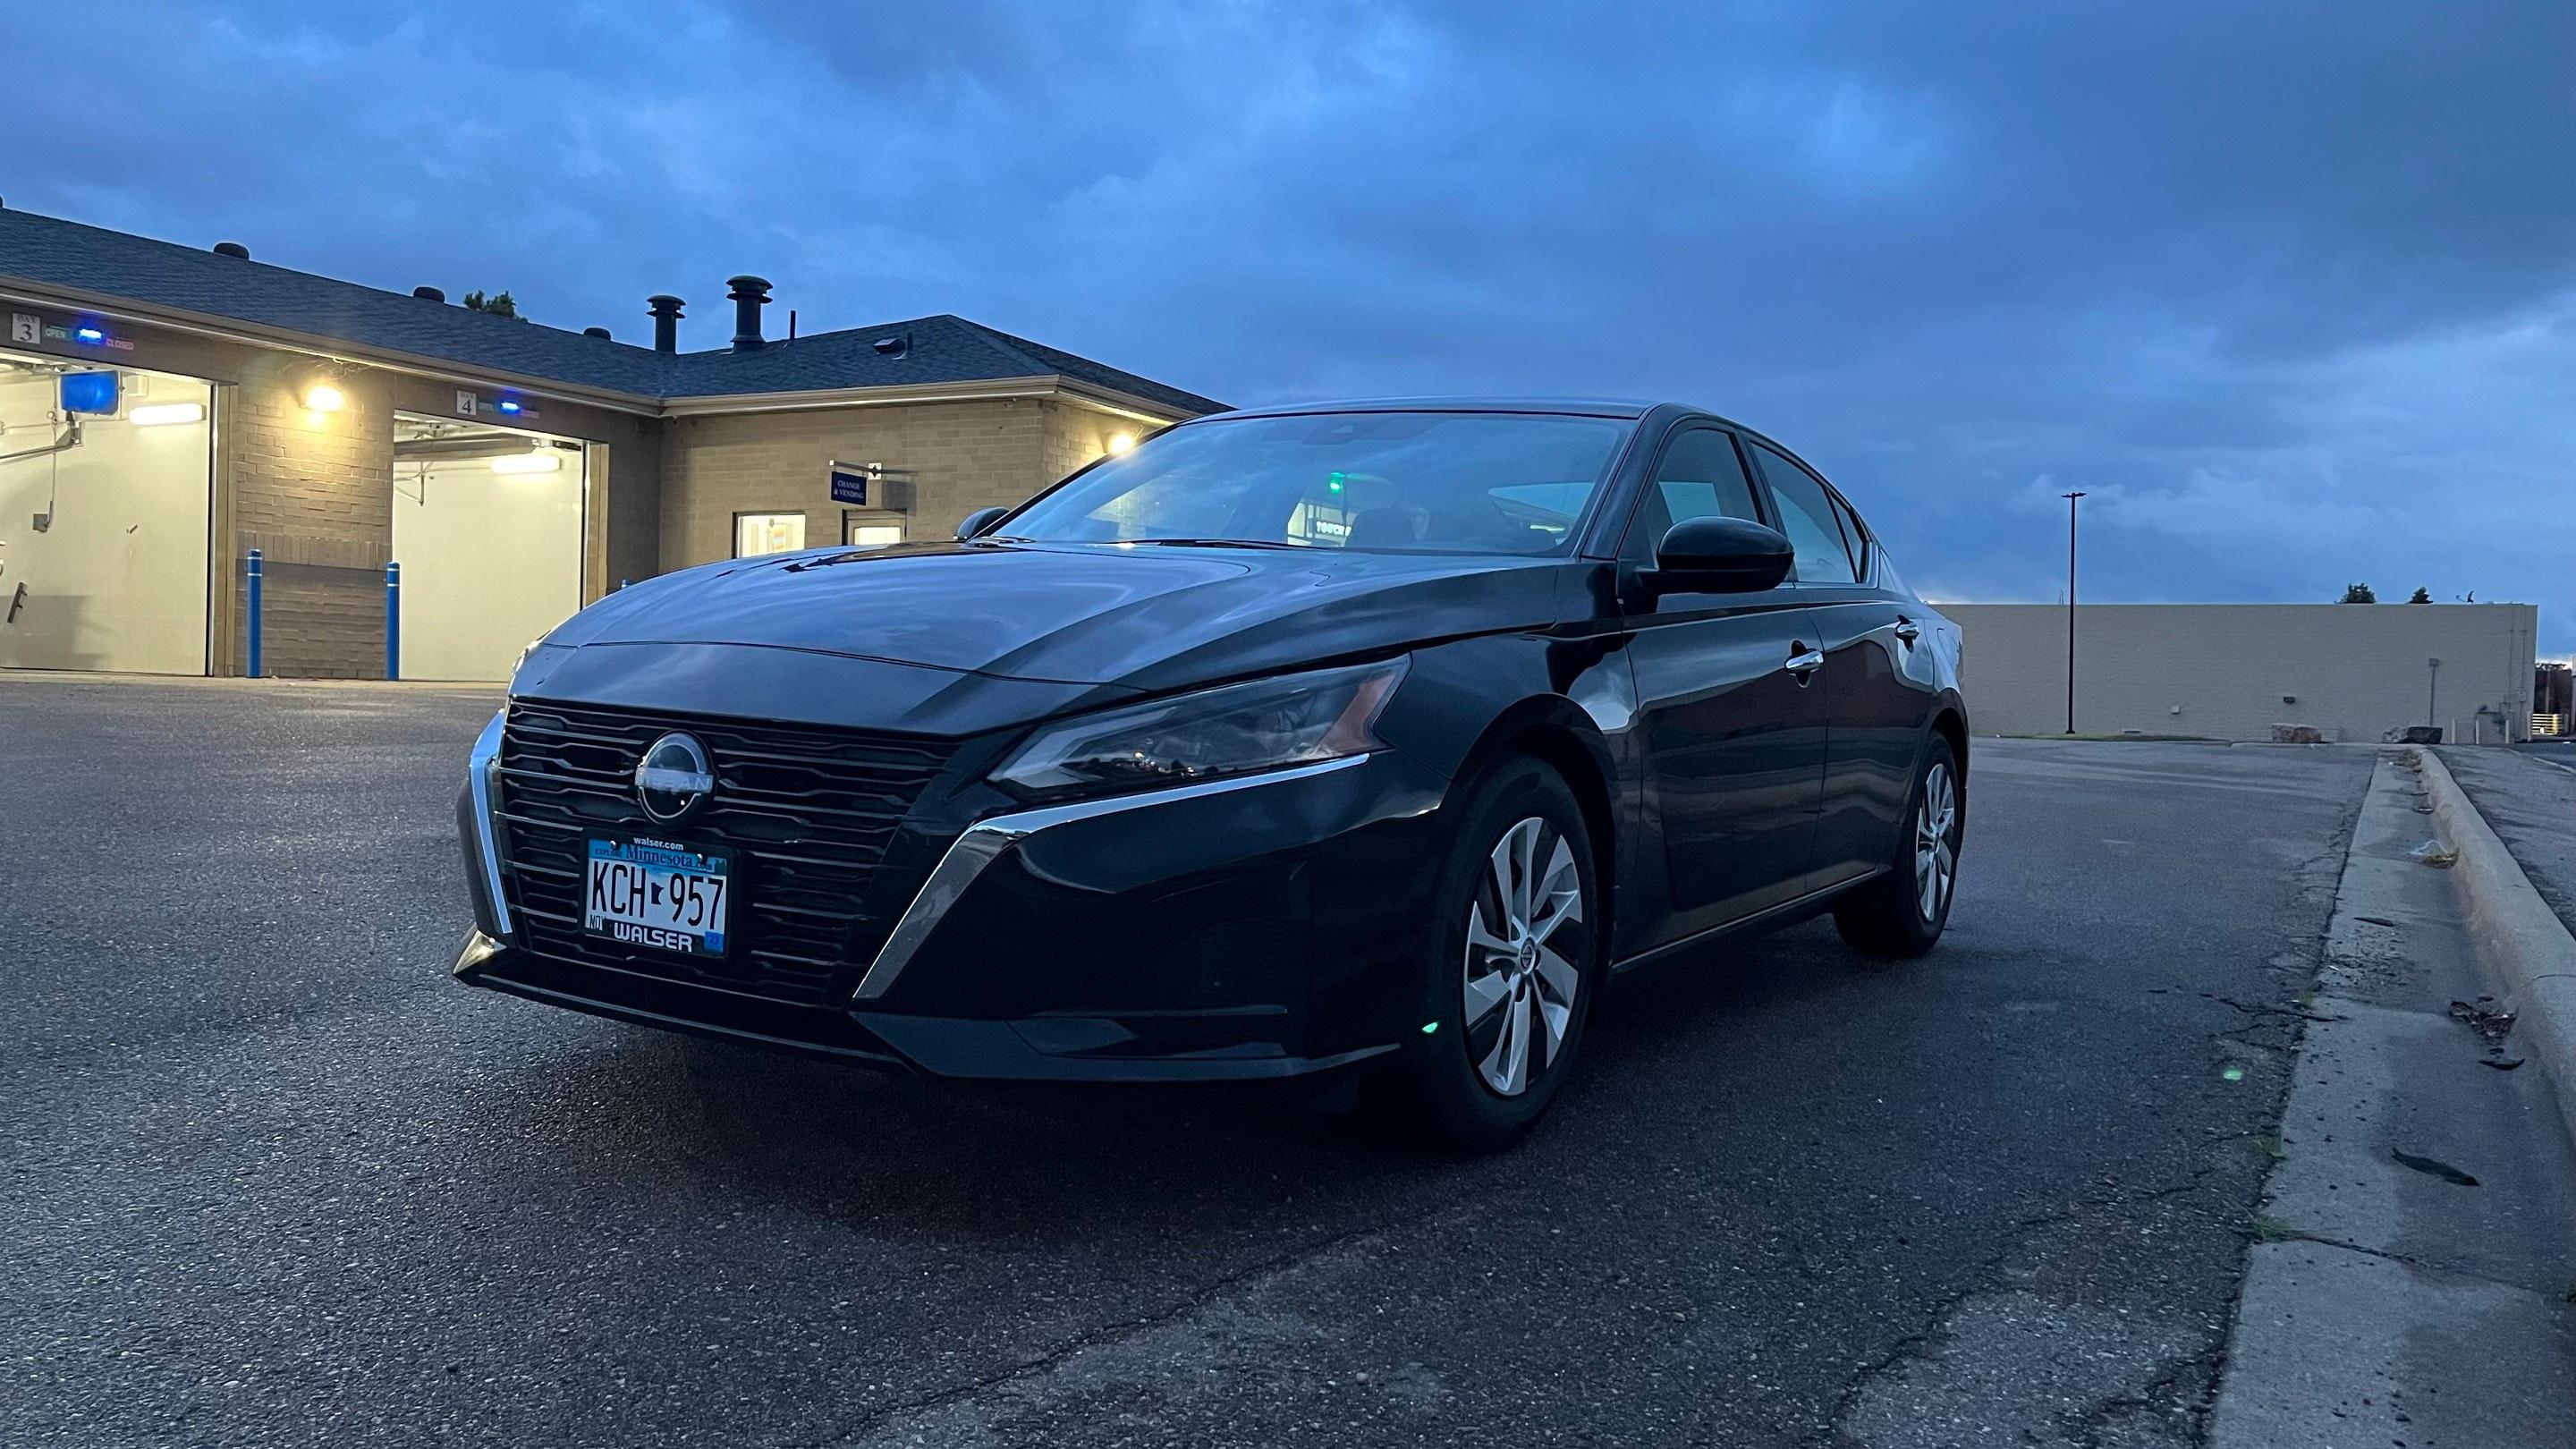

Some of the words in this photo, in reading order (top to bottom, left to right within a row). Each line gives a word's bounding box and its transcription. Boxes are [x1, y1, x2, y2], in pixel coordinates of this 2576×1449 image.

[20, 324, 32, 341] 3
[46, 328, 66, 339] OPEN
[106, 339, 133, 350] CLOSED
[462, 399, 471, 413] 4
[837, 479, 860, 490] CHANGE
[839, 488, 864, 499] VENDING
[633, 837, 684, 851] walser.com
[626, 845, 692, 867] Minnesota
[592, 861, 647, 918] KCH
[670, 872, 724, 929] 957
[614, 922, 692, 953] WALSER
